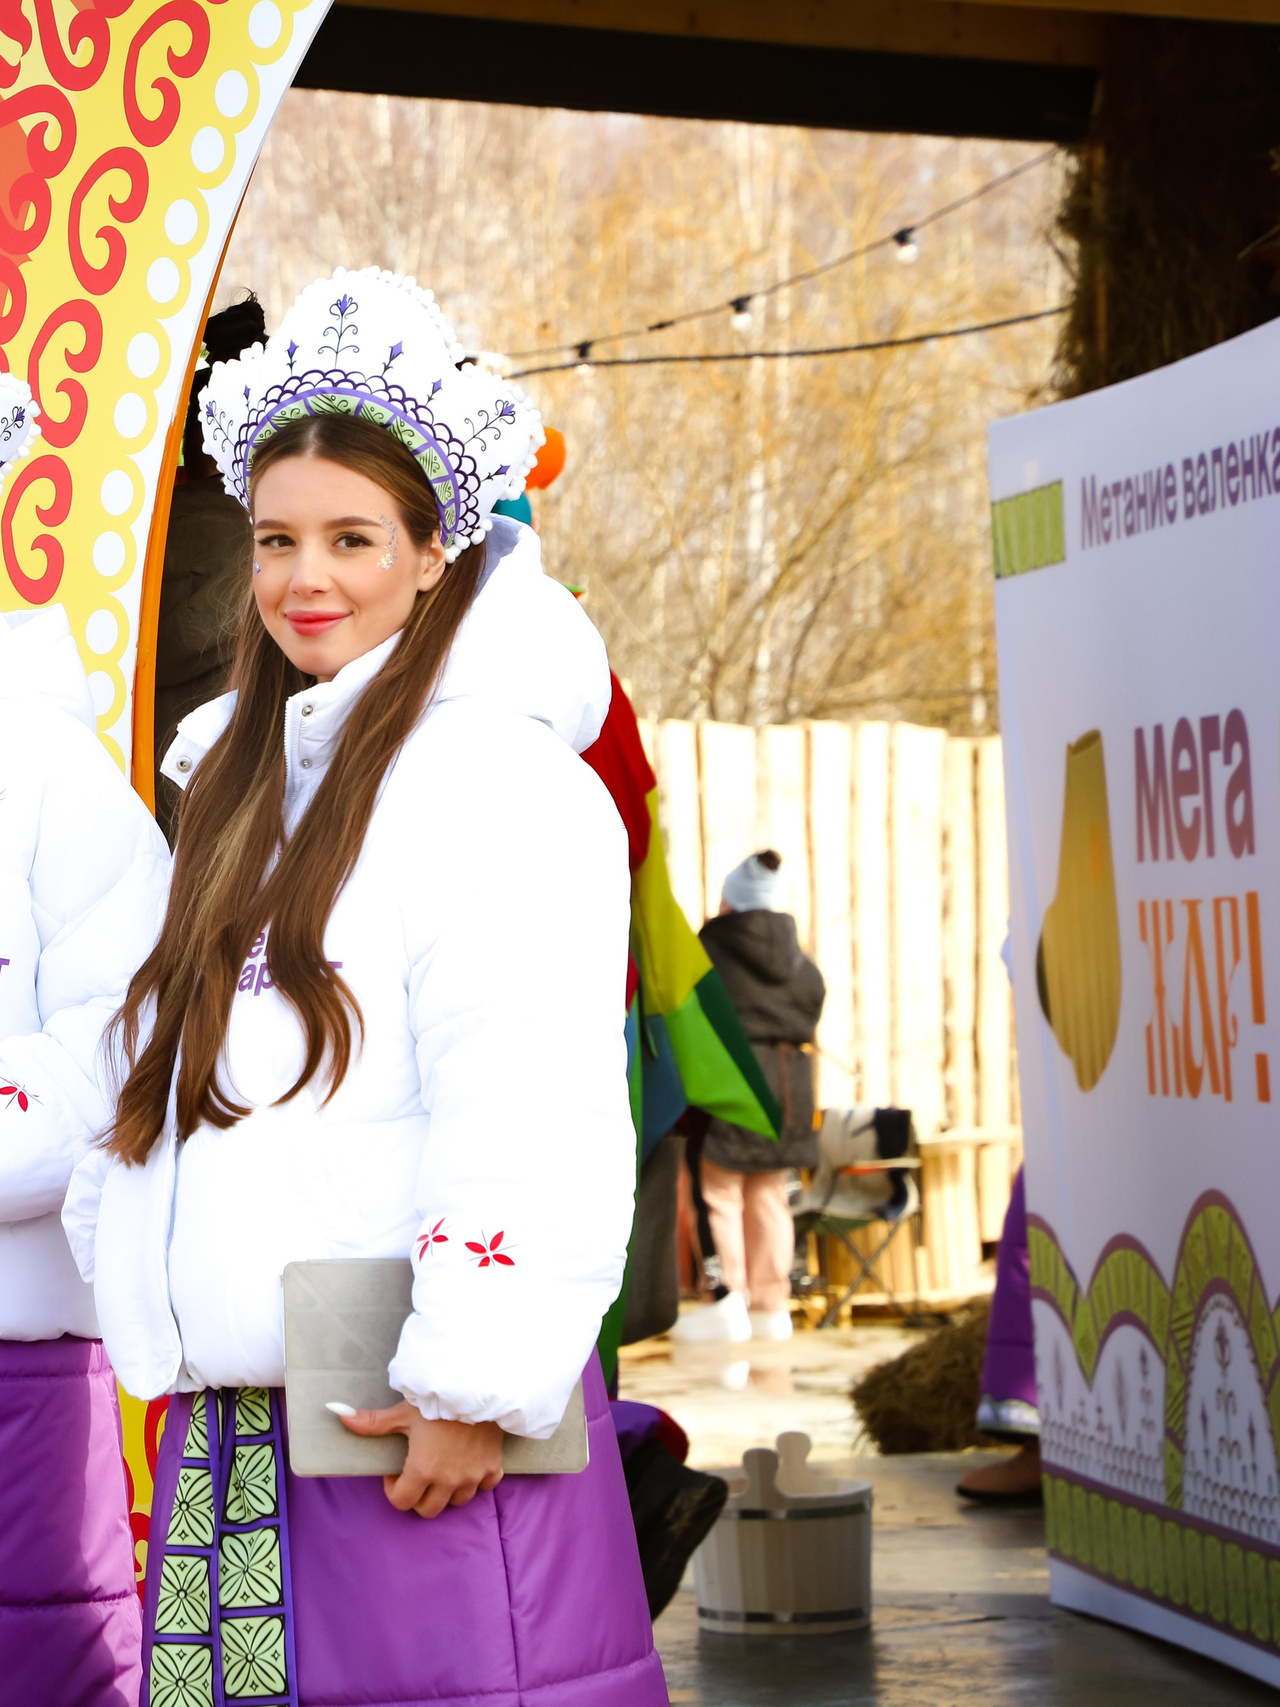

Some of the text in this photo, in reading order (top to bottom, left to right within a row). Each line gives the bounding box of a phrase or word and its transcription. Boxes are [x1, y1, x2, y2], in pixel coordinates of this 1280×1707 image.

[1080, 462, 1178, 551] Метание
[1134, 707, 1256, 864] мега
[1137, 890, 1271, 1104] ЖАР!
